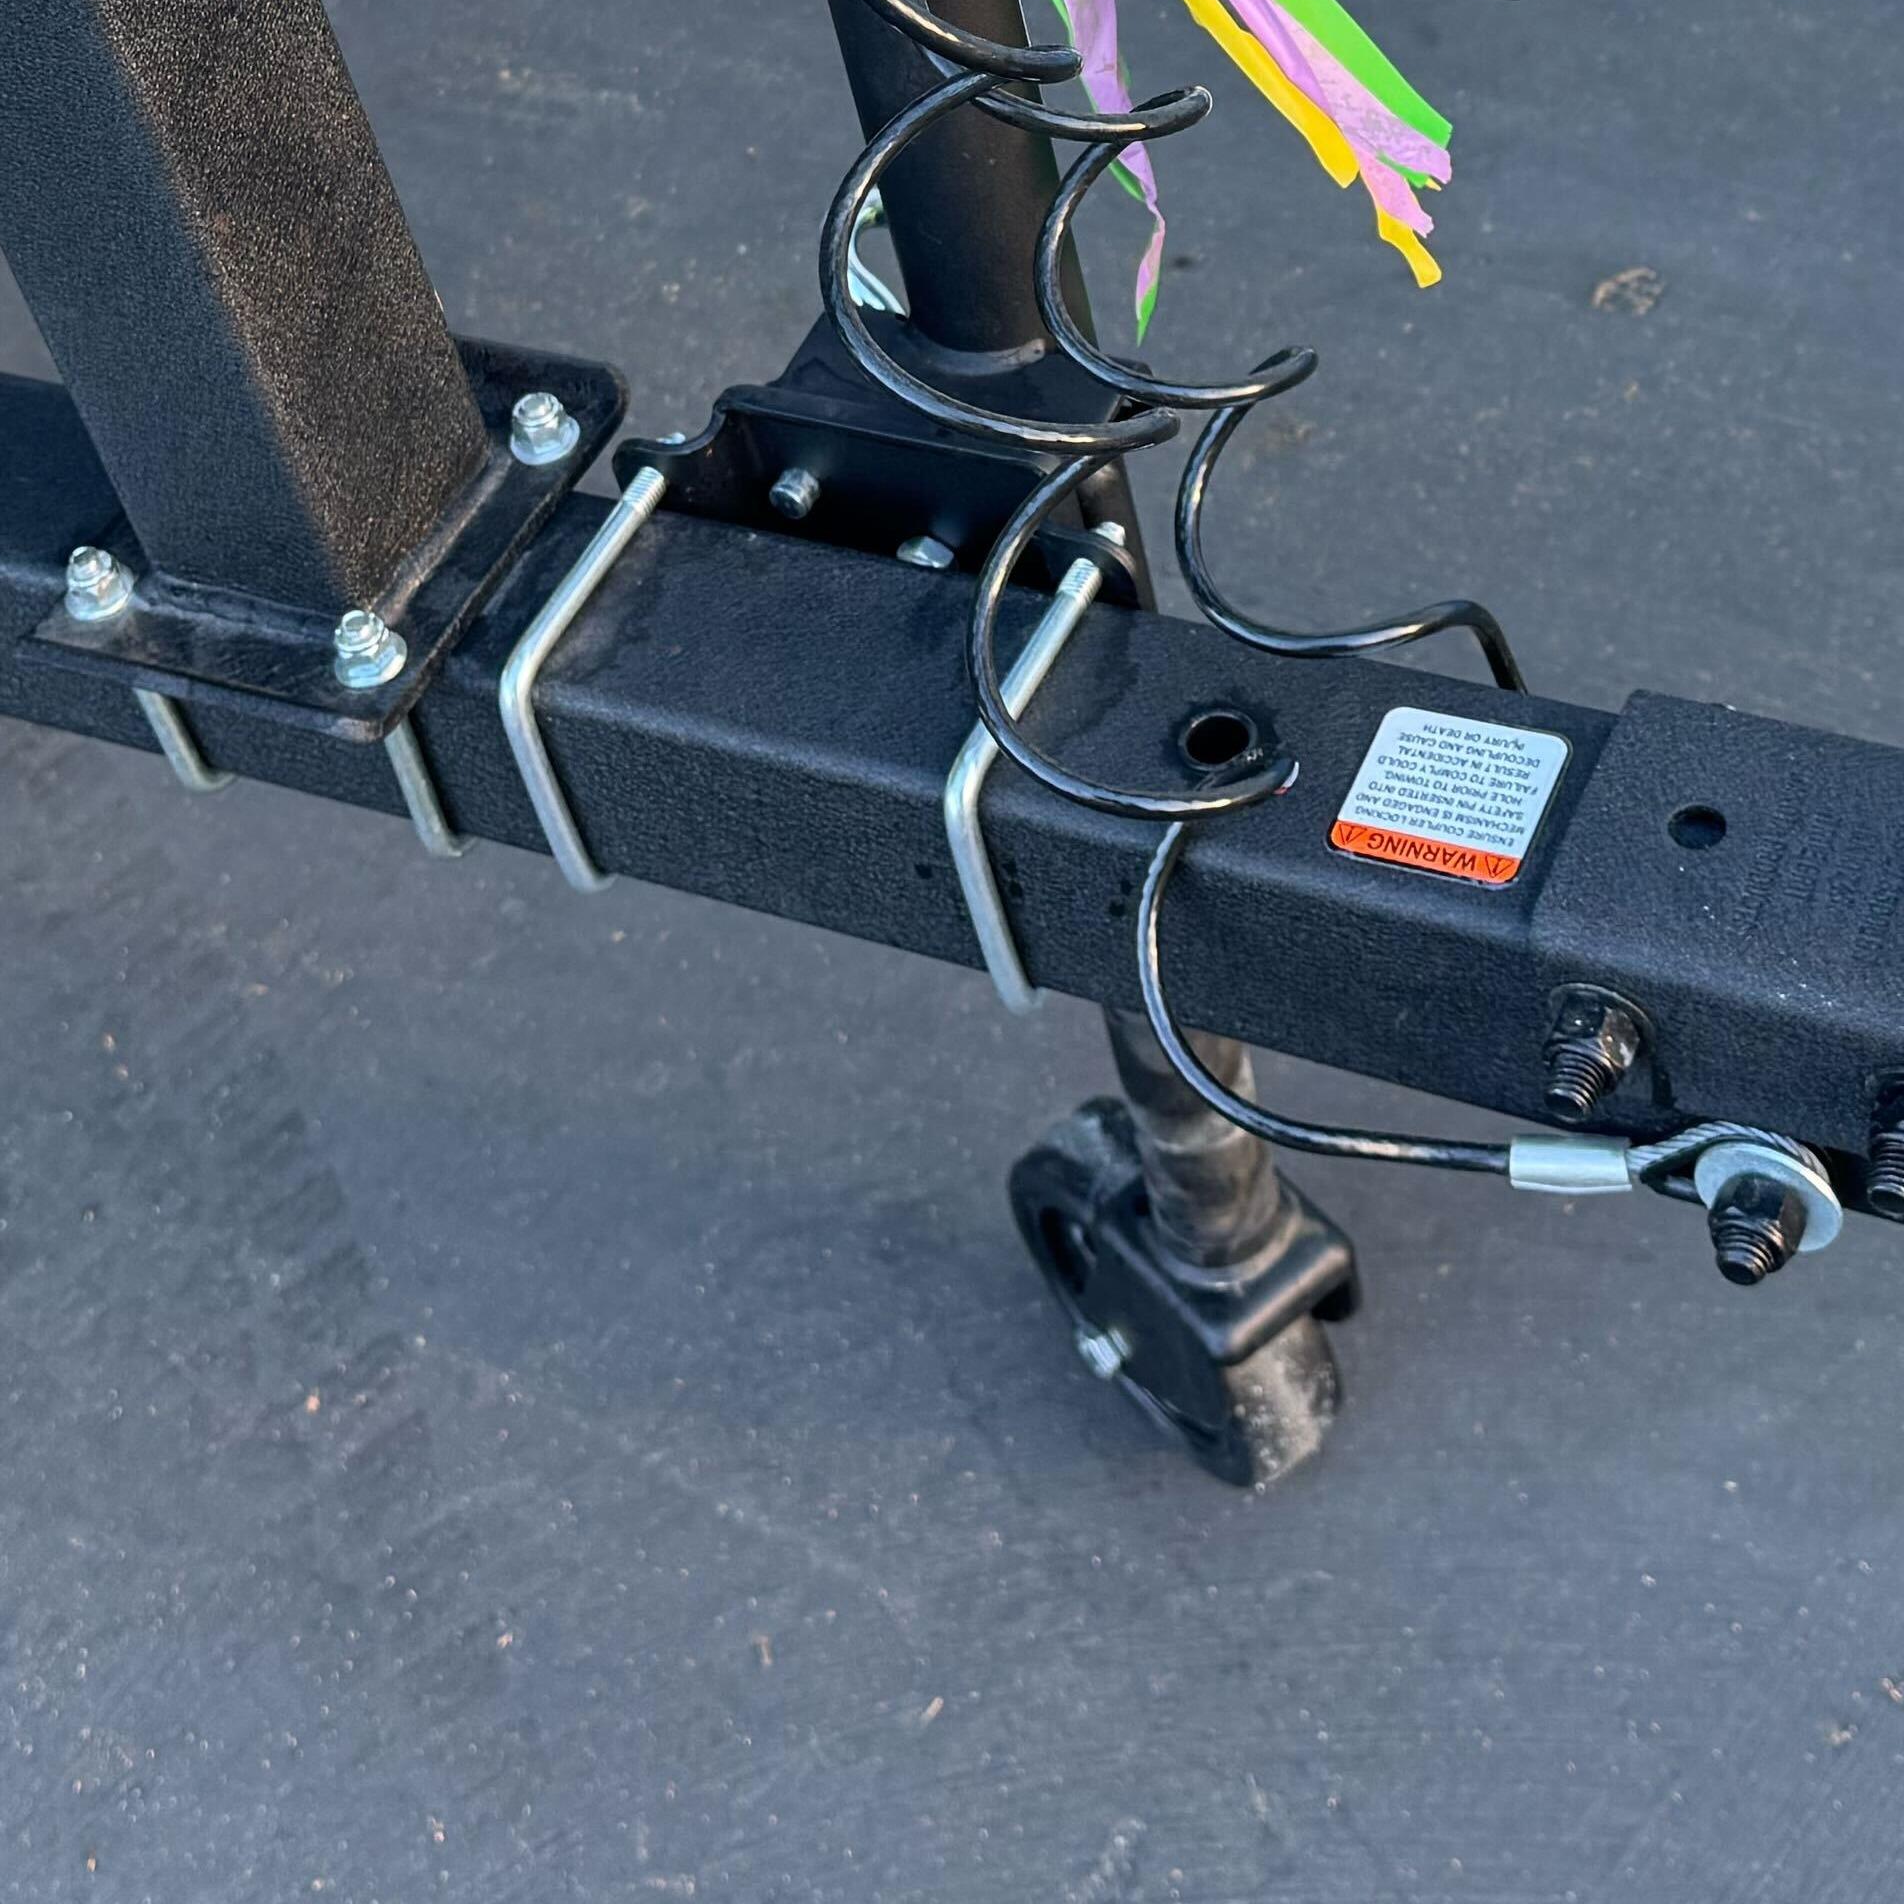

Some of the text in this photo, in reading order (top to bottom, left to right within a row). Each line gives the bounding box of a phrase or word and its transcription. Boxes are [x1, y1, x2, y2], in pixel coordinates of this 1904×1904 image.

[1397, 732, 1540, 768] DECOUPLING AND CAUSE
[1423, 724, 1525, 751] INJURY OR DEATH
[1377, 755, 1538, 795] FAILURE TO COMPLY COULD
[1399, 745, 1531, 779] RESULT IN ACCIDENTAL
[1368, 781, 1524, 821] SAFETY PIN INSERTED INTO
[1433, 780, 1448, 791] TO
[1451, 784, 1488, 799] PRIOR
[1490, 792, 1522, 806] HOLE
[1355, 806, 1514, 847] ENSURE COUPLER LOCKING
[1356, 792, 1524, 835] MECHANISM IS ENGAGED AND
[1367, 832, 1476, 871] WARNING
